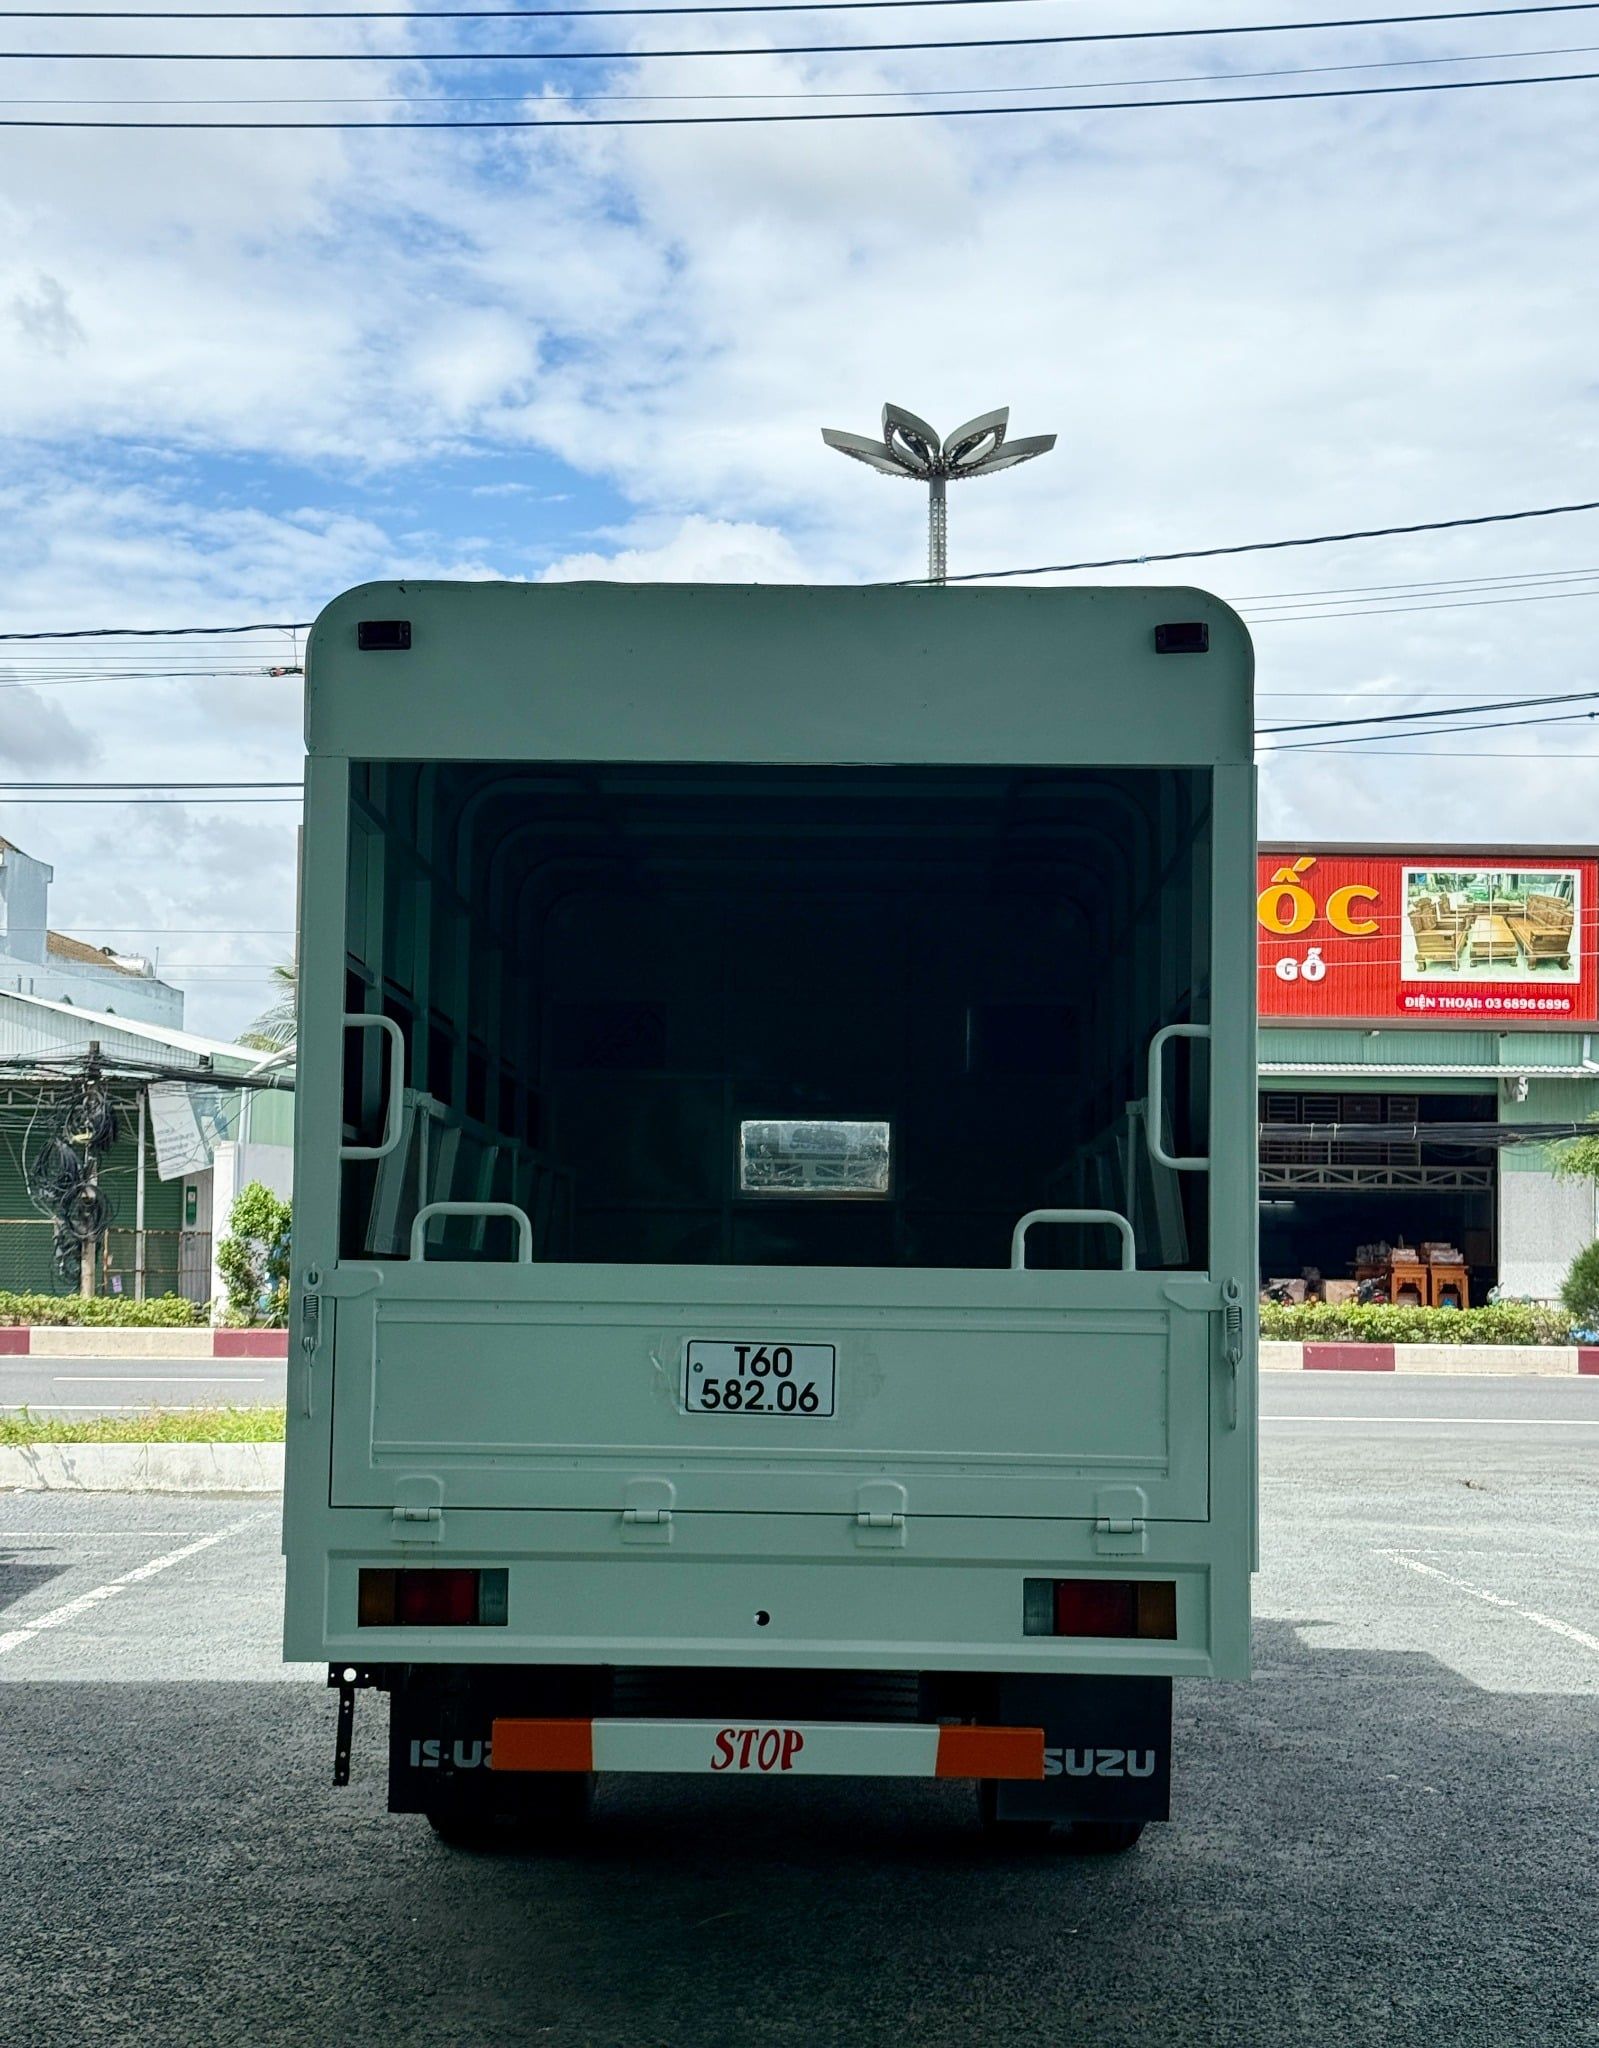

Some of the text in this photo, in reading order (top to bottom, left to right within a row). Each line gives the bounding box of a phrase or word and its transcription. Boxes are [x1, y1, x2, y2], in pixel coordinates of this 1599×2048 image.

[1257, 857, 1379, 935] ỐC
[1275, 947, 1326, 981] GỖ
[1405, 994, 1435, 1010] ĐIỆN
[1438, 998, 1482, 1011] THOẠI:
[734, 1346, 792, 1378] T60
[700, 1379, 819, 1412] 582.06
[711, 1728, 804, 1771] STOP
